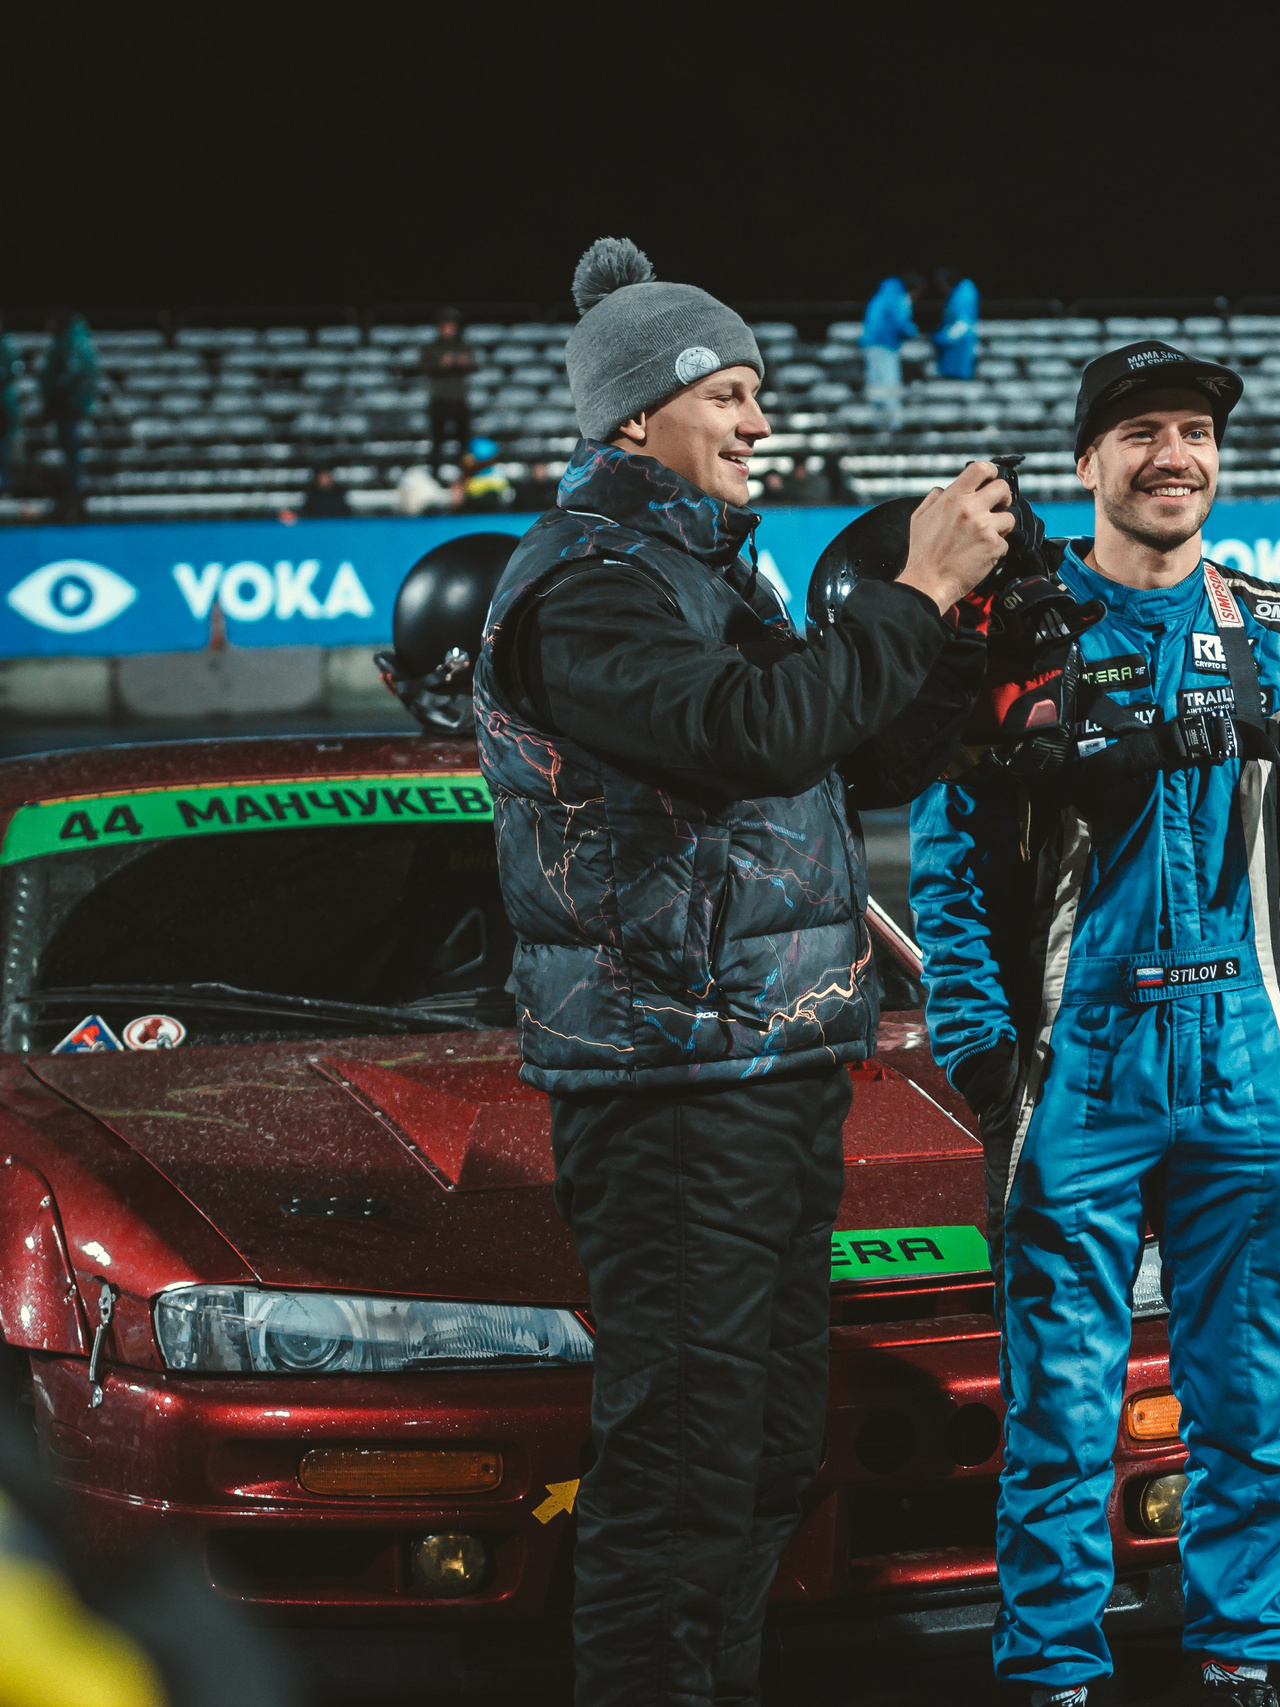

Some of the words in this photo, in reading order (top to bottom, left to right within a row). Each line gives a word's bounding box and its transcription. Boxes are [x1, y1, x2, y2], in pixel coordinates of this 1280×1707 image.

[1127, 350, 1160, 365] MAMA
[1160, 350, 1184, 361] SAYS
[173, 558, 374, 622] VOKA
[1206, 566, 1235, 620] SIMPSON
[1194, 660, 1221, 670] CRYPTO
[59, 804, 143, 842] 44
[175, 786, 494, 829] МАНЧУКЕВ
[1170, 964, 1217, 983] STILOV
[1225, 961, 1237, 976] S.
